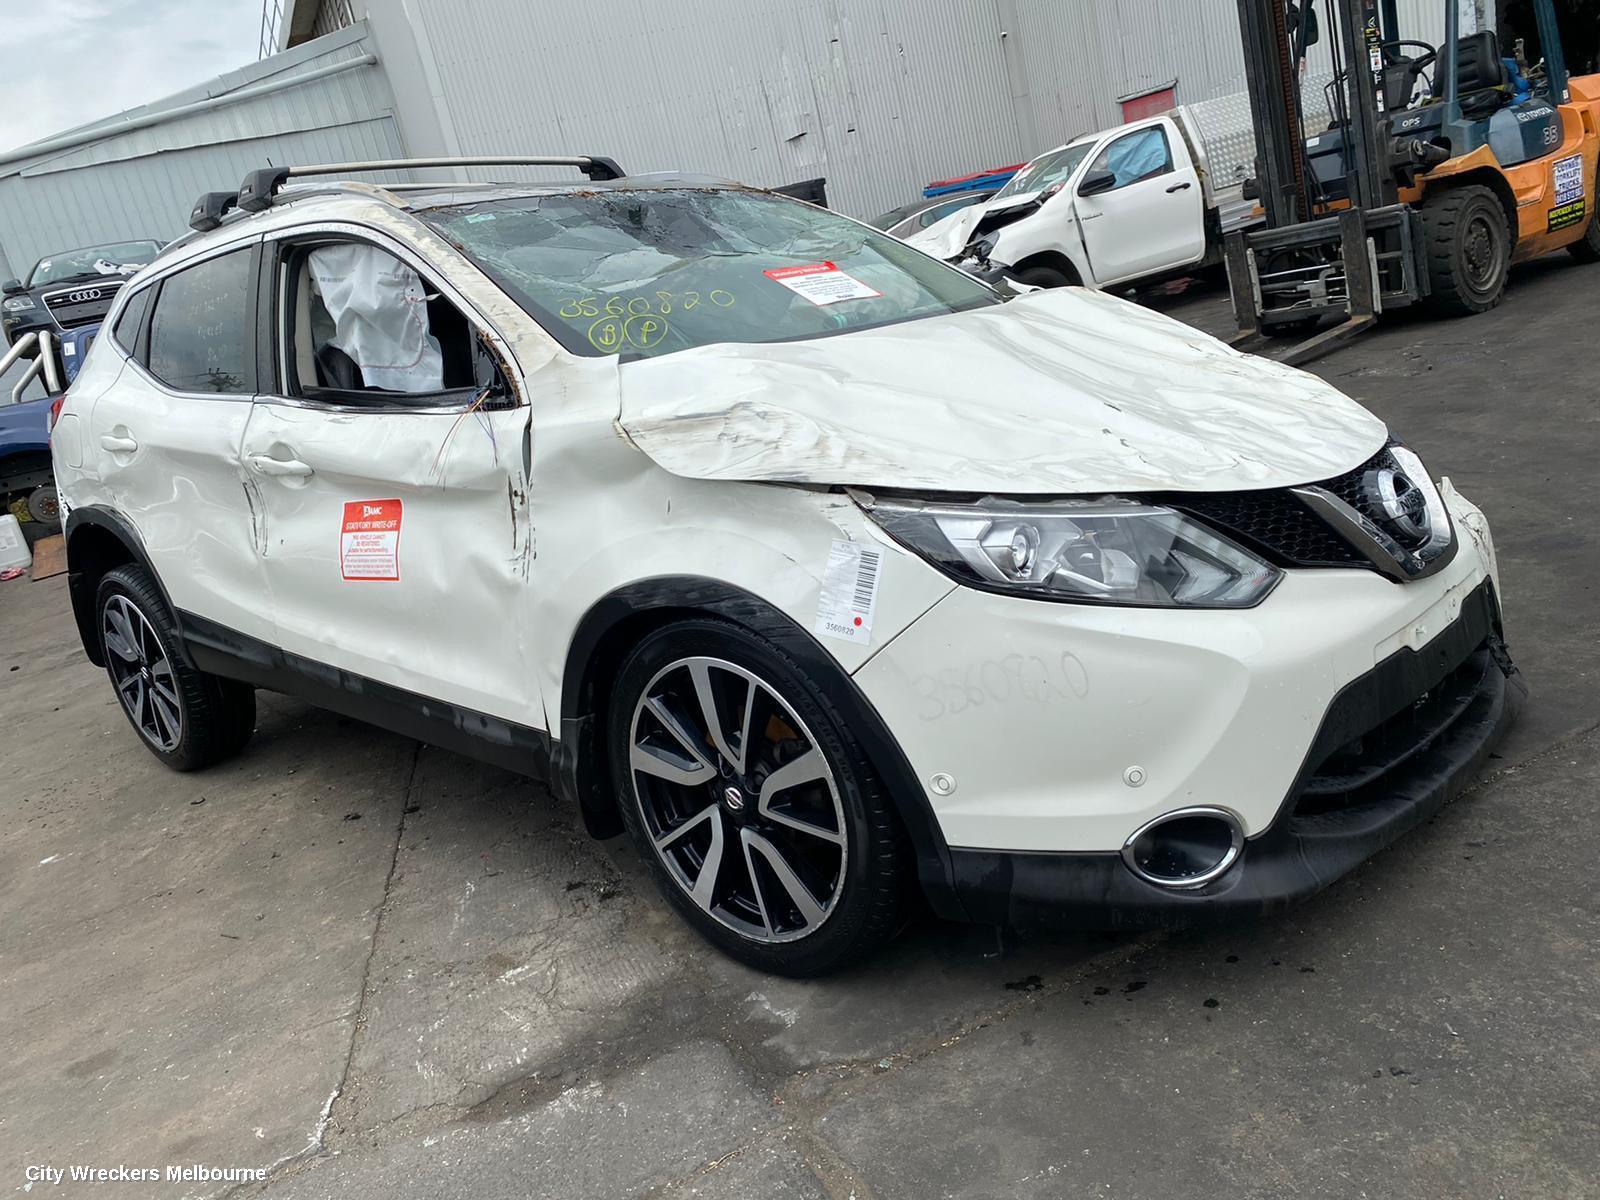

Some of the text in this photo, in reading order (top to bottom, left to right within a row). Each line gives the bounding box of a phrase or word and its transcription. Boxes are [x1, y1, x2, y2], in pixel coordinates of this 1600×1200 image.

[1526, 106, 1553, 119] TOYOTA
[1402, 117, 1420, 127] OPS
[1543, 125, 1558, 145] 35
[1556, 168, 1581, 181] FORKLIFT
[1558, 177, 1580, 191] TRUCKS
[560, 290, 735, 317] 3560820
[345, 520, 397, 530] STATUTORY WRITE-OFF
[825, 622, 855, 636] 3560820
